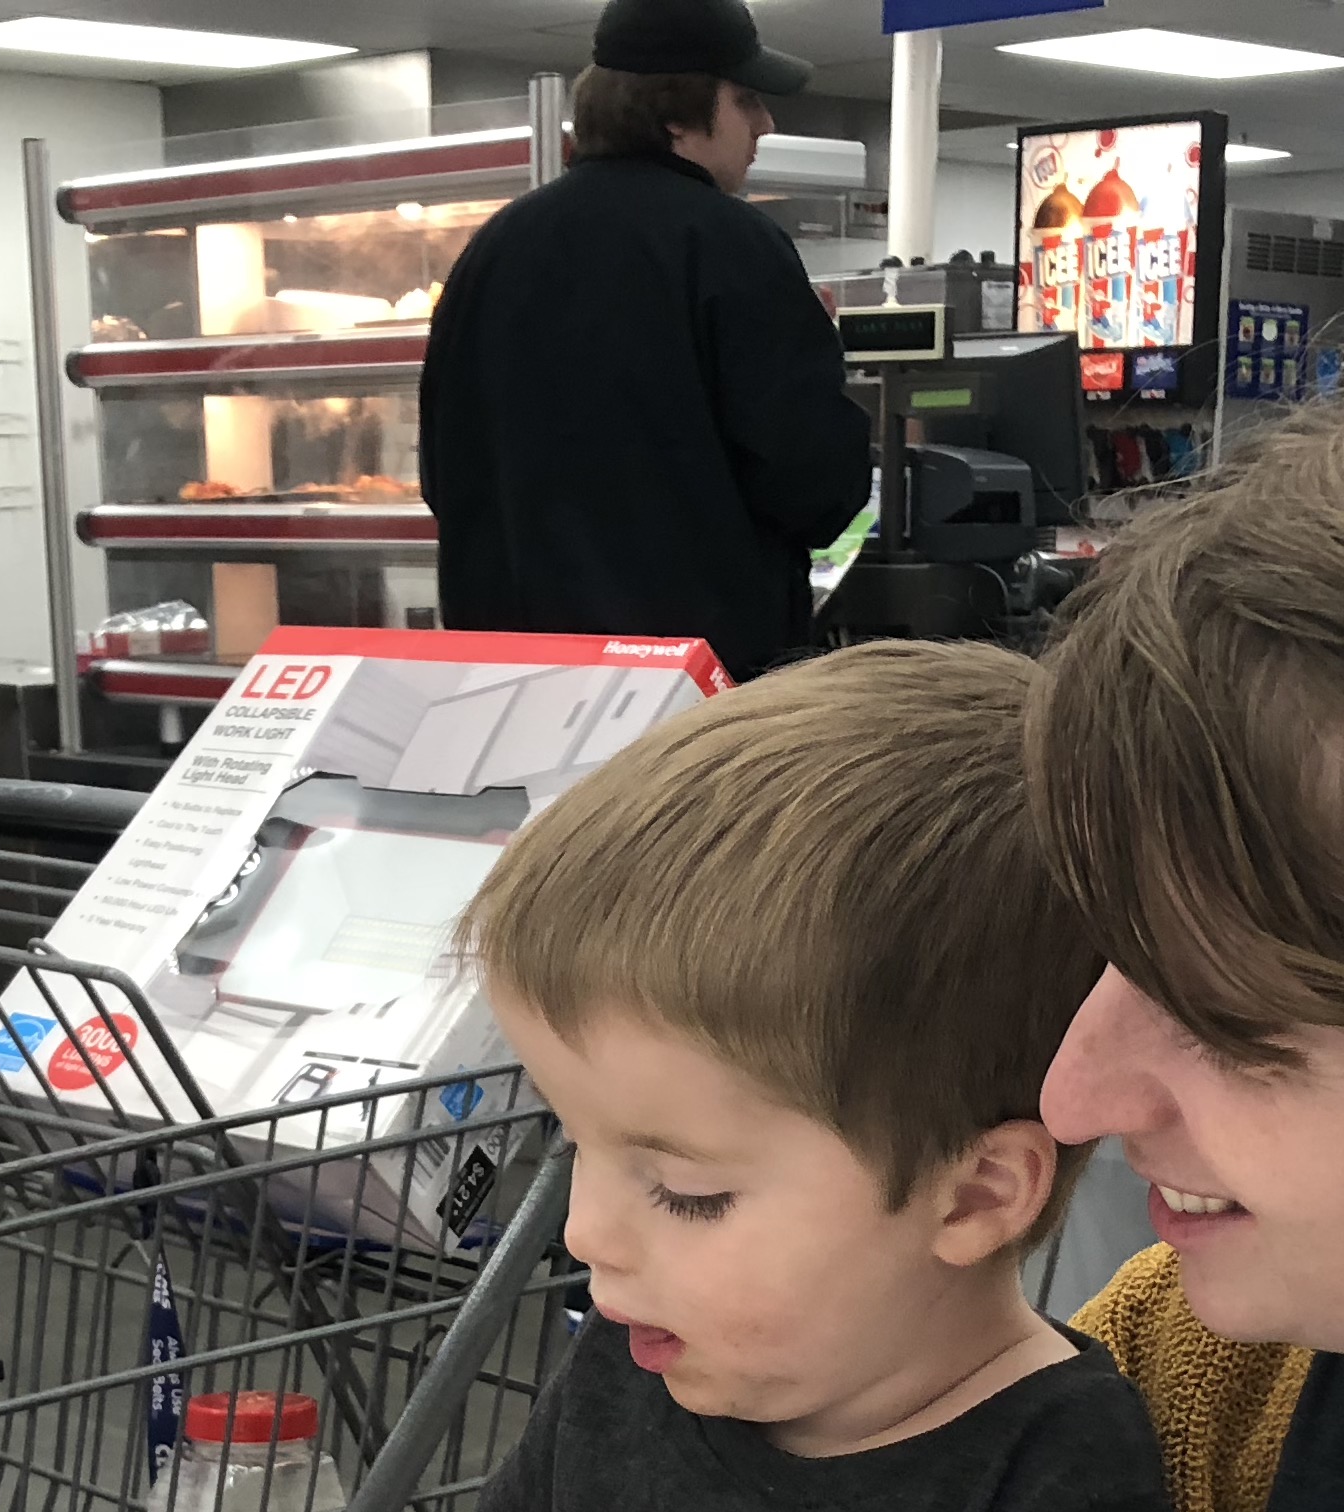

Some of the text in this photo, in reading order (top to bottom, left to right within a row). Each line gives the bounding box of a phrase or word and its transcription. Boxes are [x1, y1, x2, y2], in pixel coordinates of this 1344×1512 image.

[1039, 243, 1079, 287] ICEE
[1088, 236, 1131, 280] ICEE
[1139, 237, 1181, 282] ICEE
[602, 640, 691, 659] Honeywell
[241, 665, 332, 701] LED
[225, 705, 317, 721] COLLAPSIBLE
[212, 724, 296, 740] WORK LIGHT
[181, 768, 250, 785] Light Head
[191, 755, 273, 775] With Rotating
[78, 1024, 133, 1053] 3000
[61, 1046, 114, 1069] LUENS
[166, 1335, 181, 1385] Alwys
